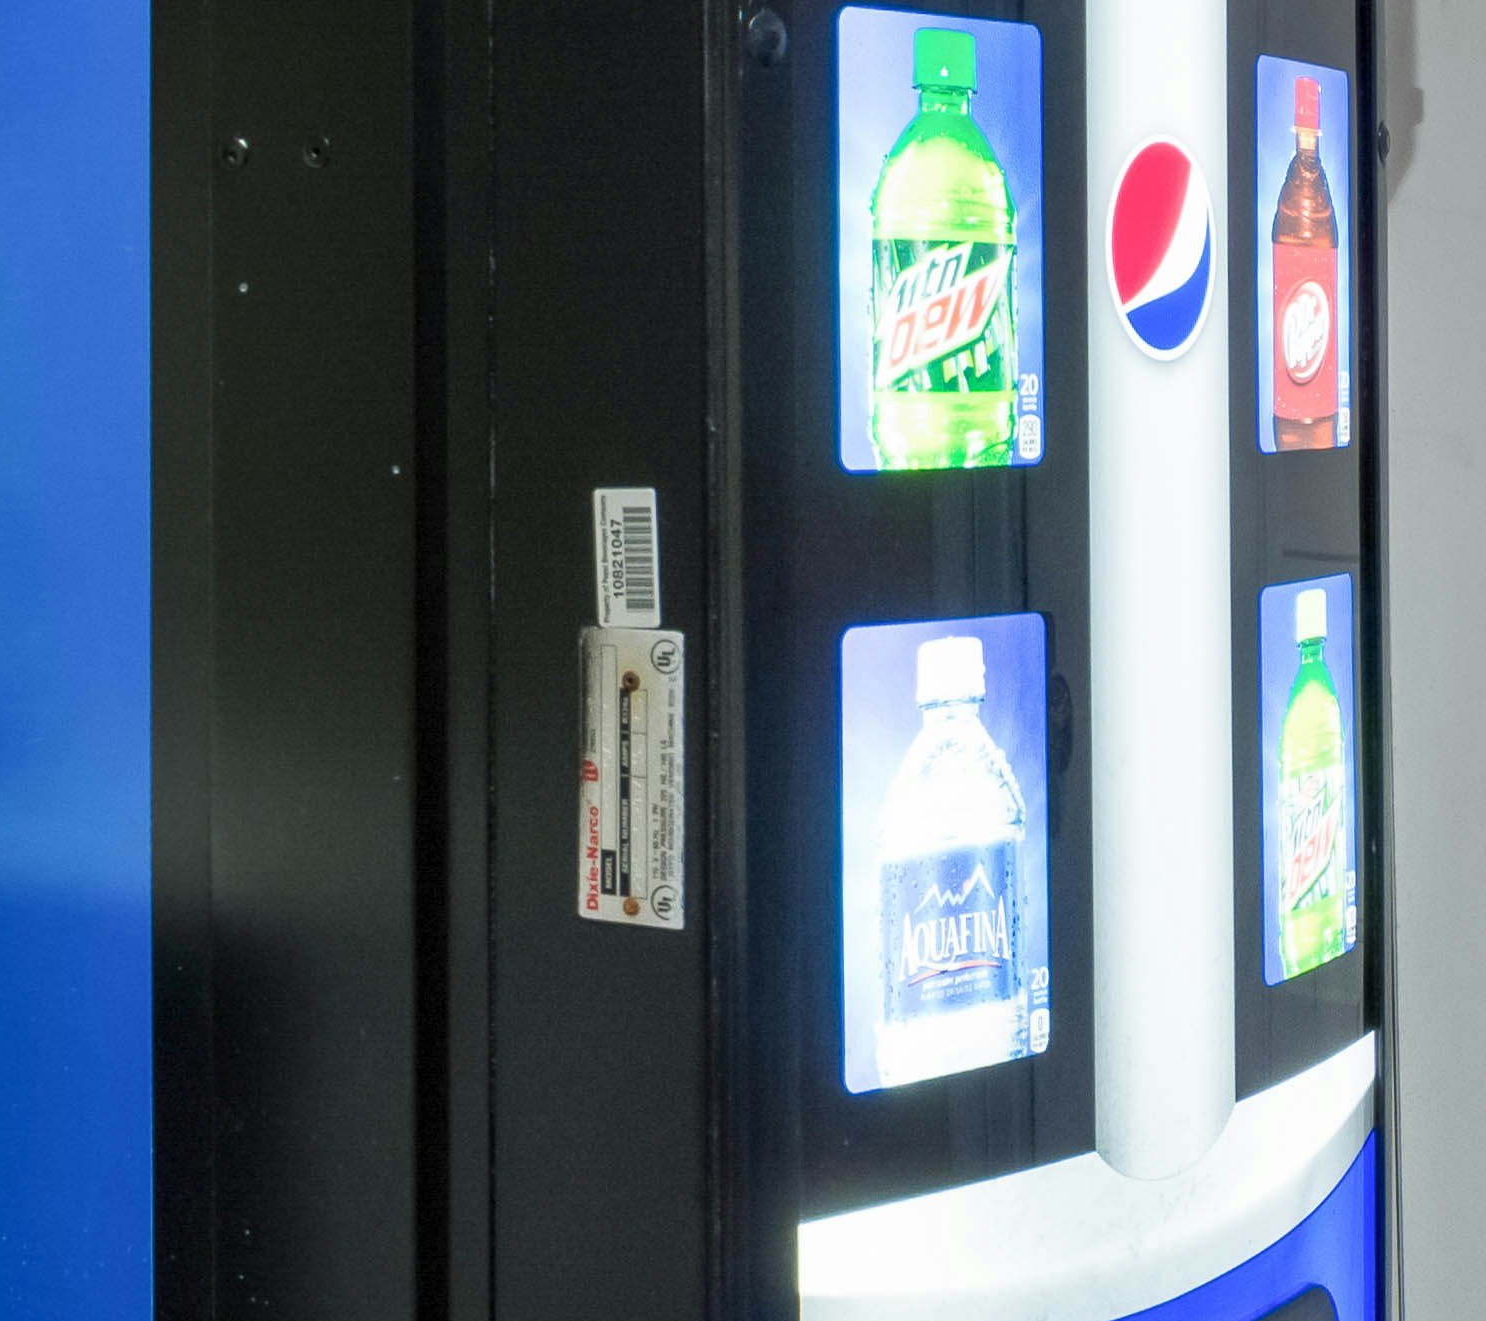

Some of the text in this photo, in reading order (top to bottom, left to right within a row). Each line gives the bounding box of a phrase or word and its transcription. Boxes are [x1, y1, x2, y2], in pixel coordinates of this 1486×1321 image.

[1019, 373, 1039, 396] 20
[610, 518, 625, 599] 10821047
[586, 805, 599, 911] Dixie-Narco
[604, 855, 613, 890] MODEL
[898, 895, 1012, 981] AQUAFINA
[1030, 966, 1049, 991] 20
